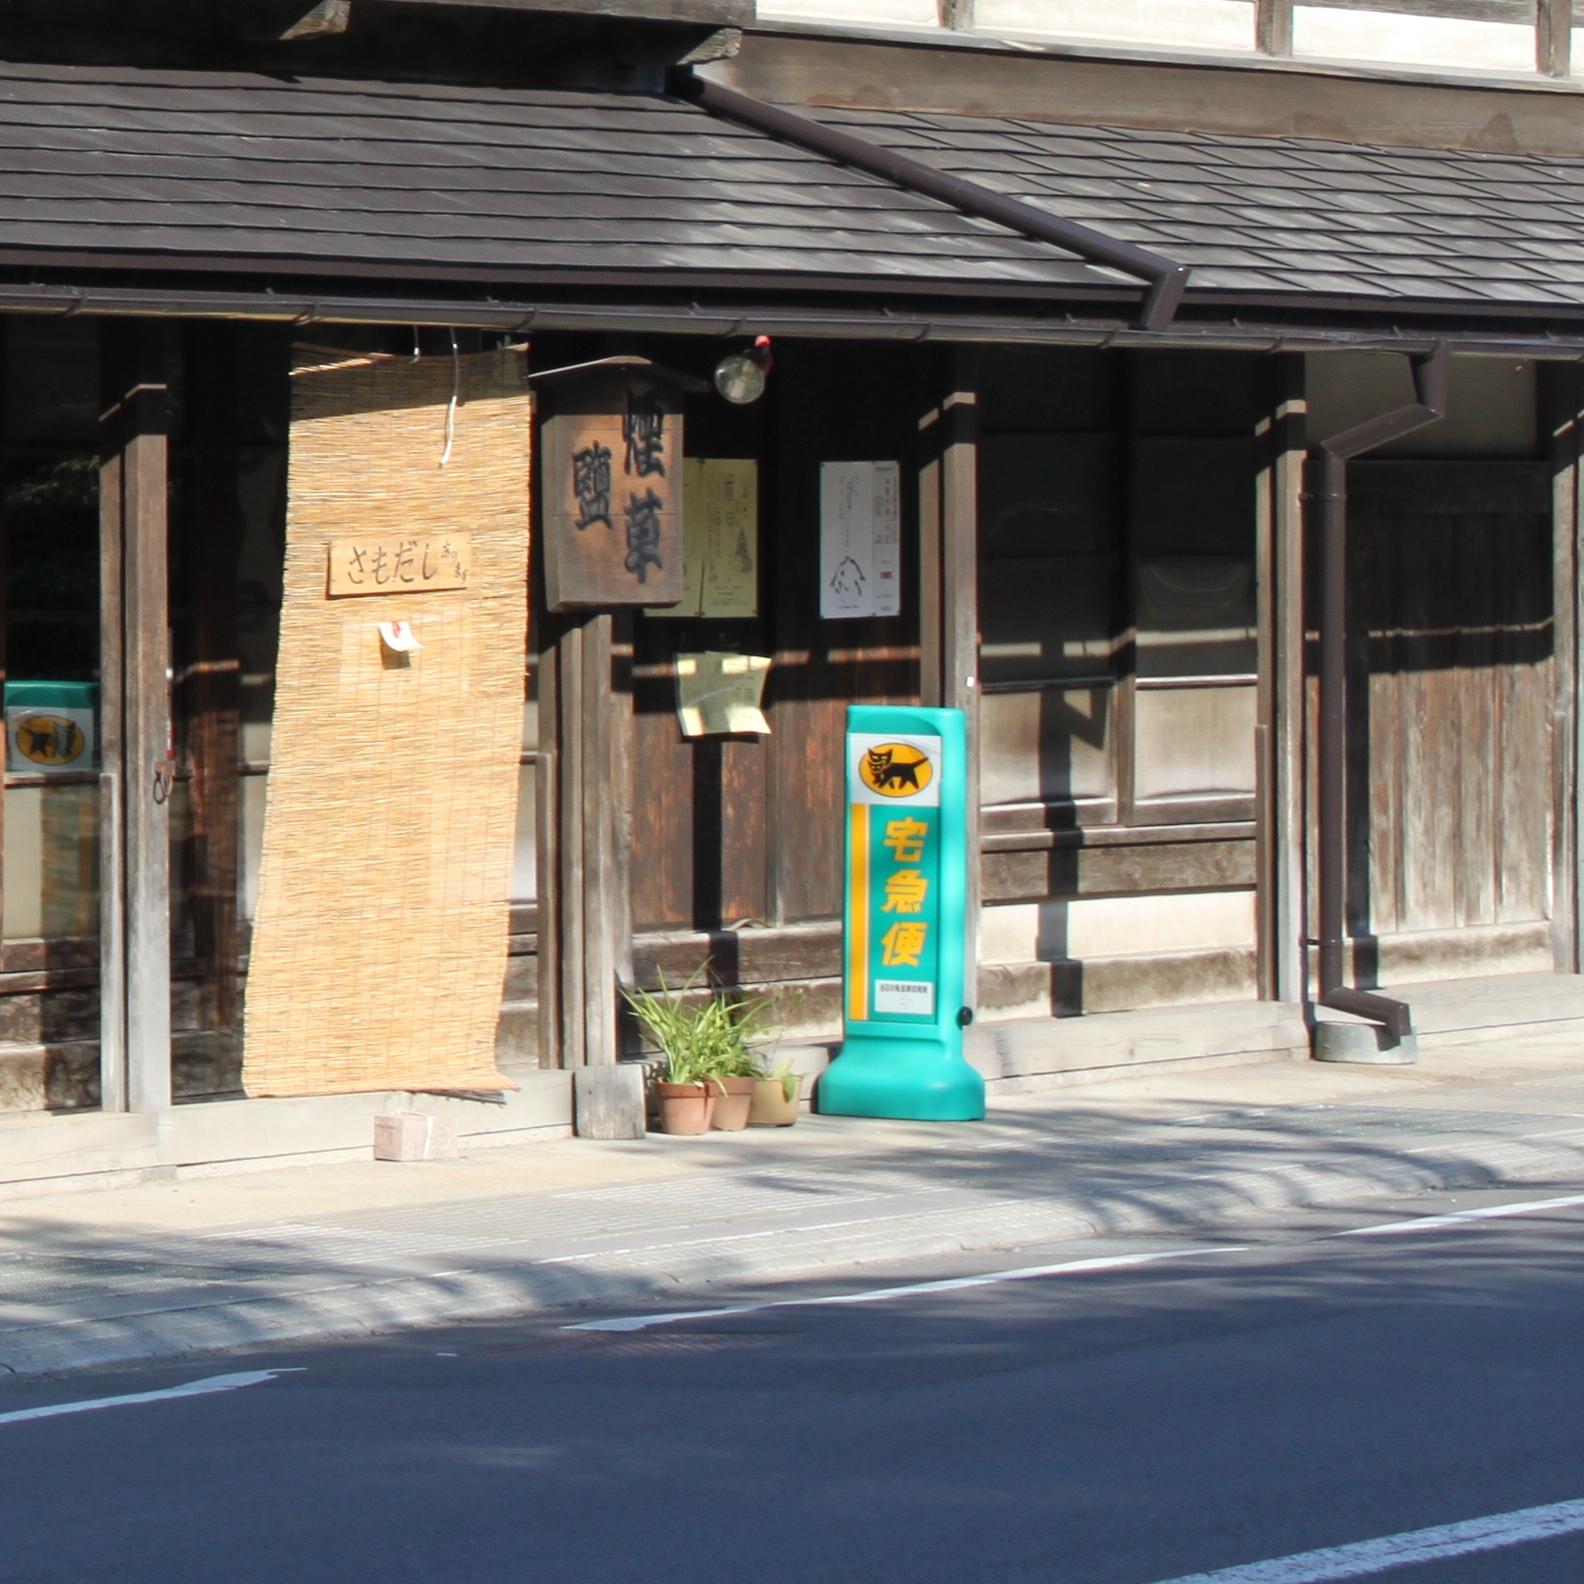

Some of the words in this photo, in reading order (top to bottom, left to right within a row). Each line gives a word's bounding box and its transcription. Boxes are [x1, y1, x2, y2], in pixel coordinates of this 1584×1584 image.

[346, 540, 437, 585] さもだし
[879, 816, 929, 967] 宅急便
